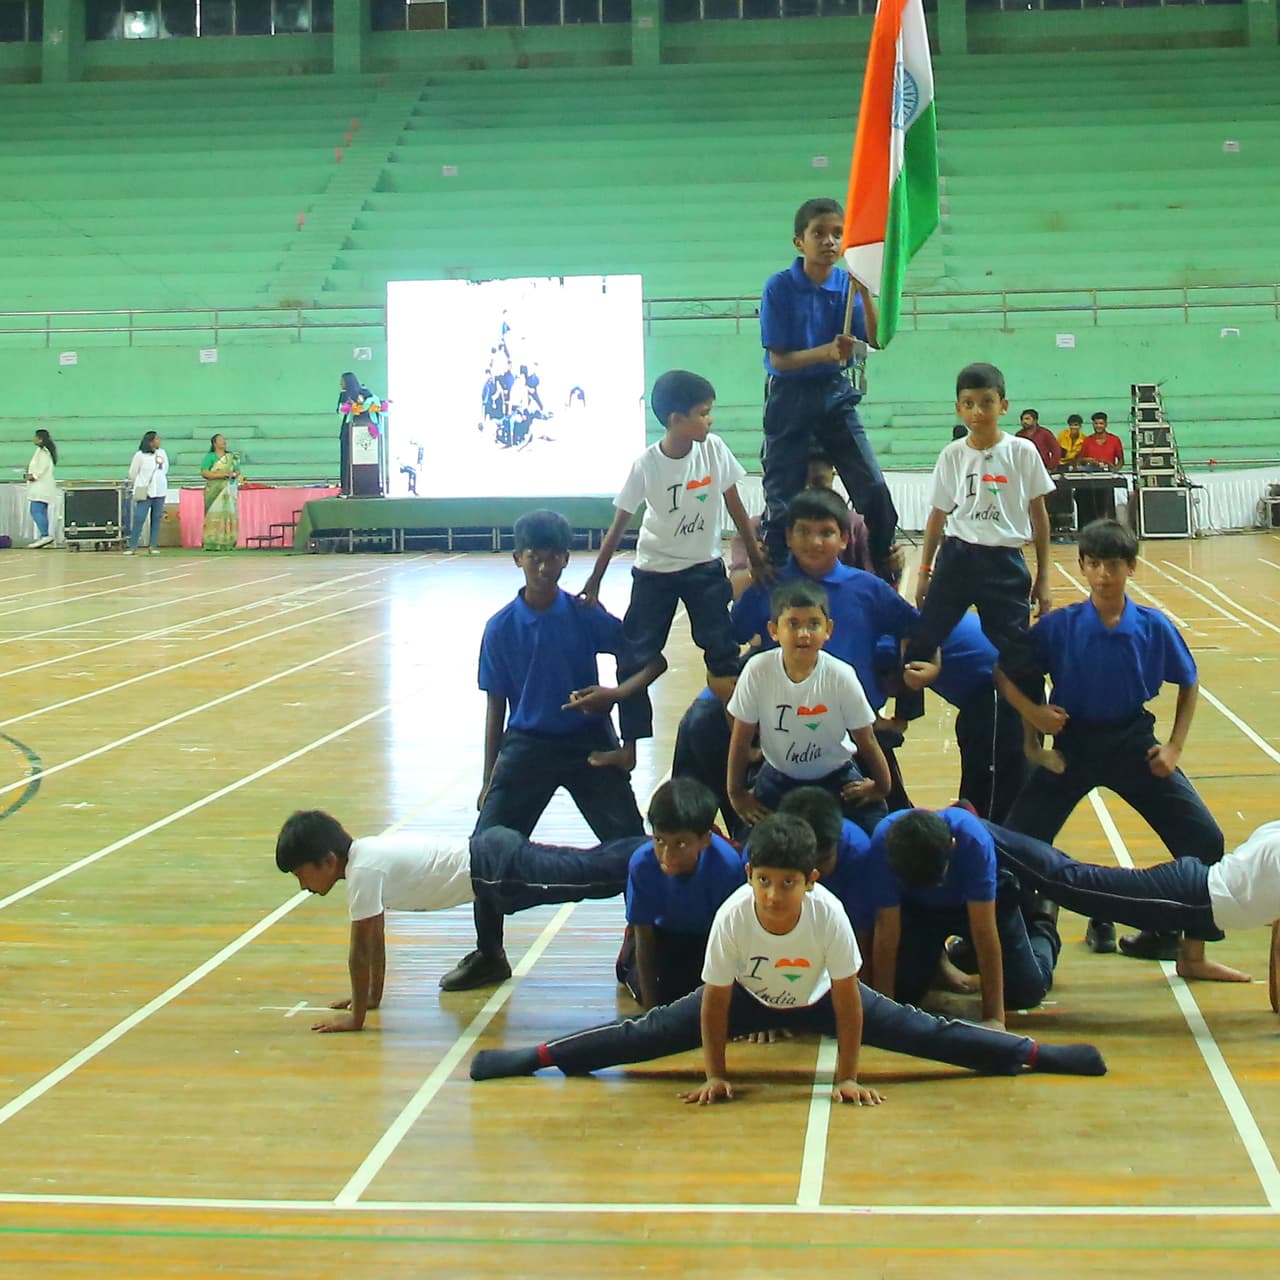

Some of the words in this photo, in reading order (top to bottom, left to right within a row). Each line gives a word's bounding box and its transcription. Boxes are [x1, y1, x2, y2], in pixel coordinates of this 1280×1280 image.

[966, 473, 978, 498] I
[667, 483, 683, 514] I
[774, 704, 793, 733] I
[785, 741, 822, 764] India
[743, 956, 769, 981] I
